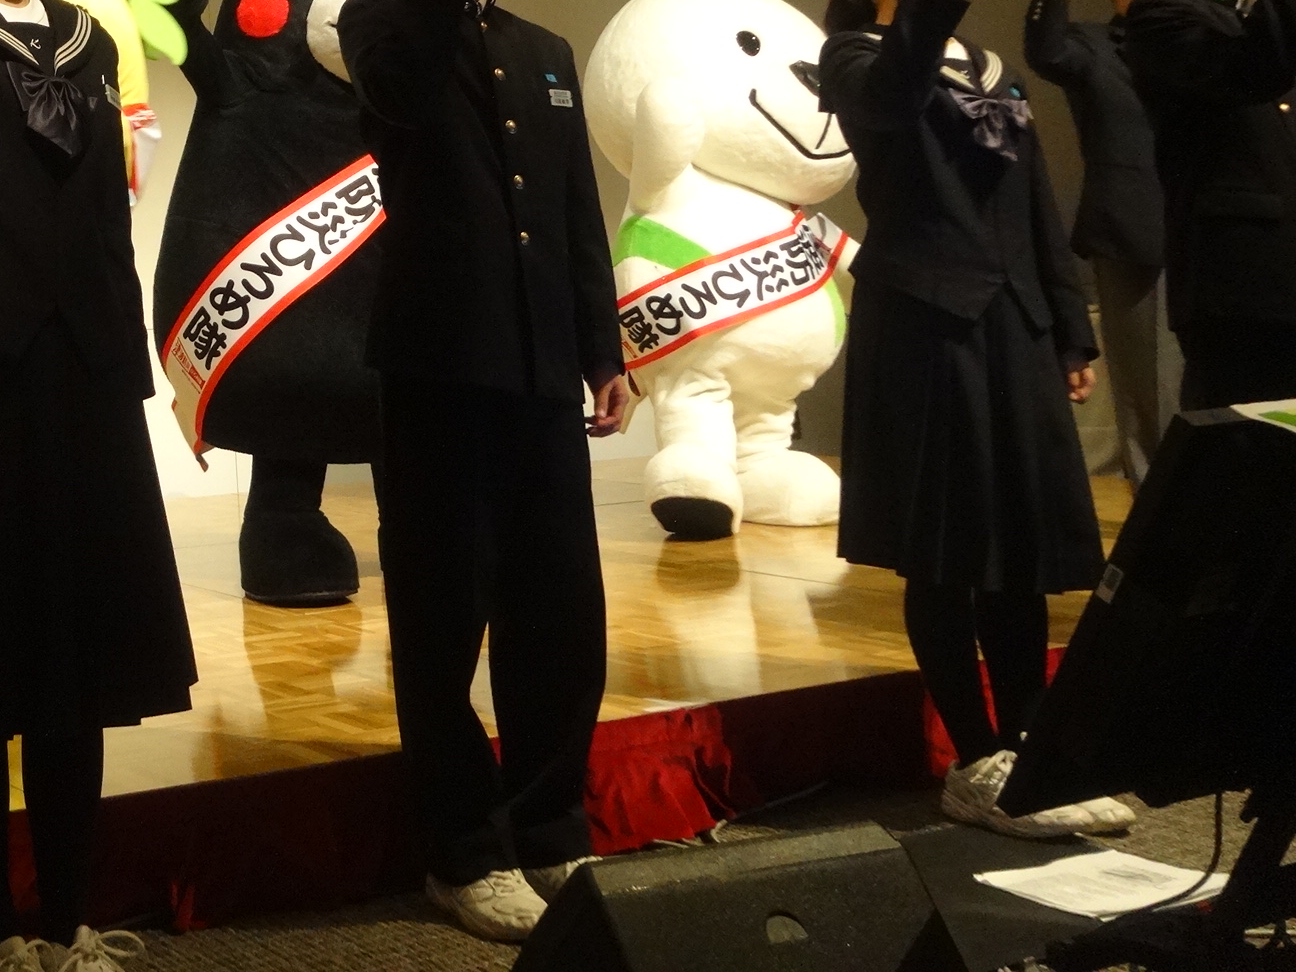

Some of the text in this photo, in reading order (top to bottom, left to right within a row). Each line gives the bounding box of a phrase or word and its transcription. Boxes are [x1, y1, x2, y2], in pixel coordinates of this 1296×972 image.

[182, 167, 382, 371] 防災ひろめ隊
